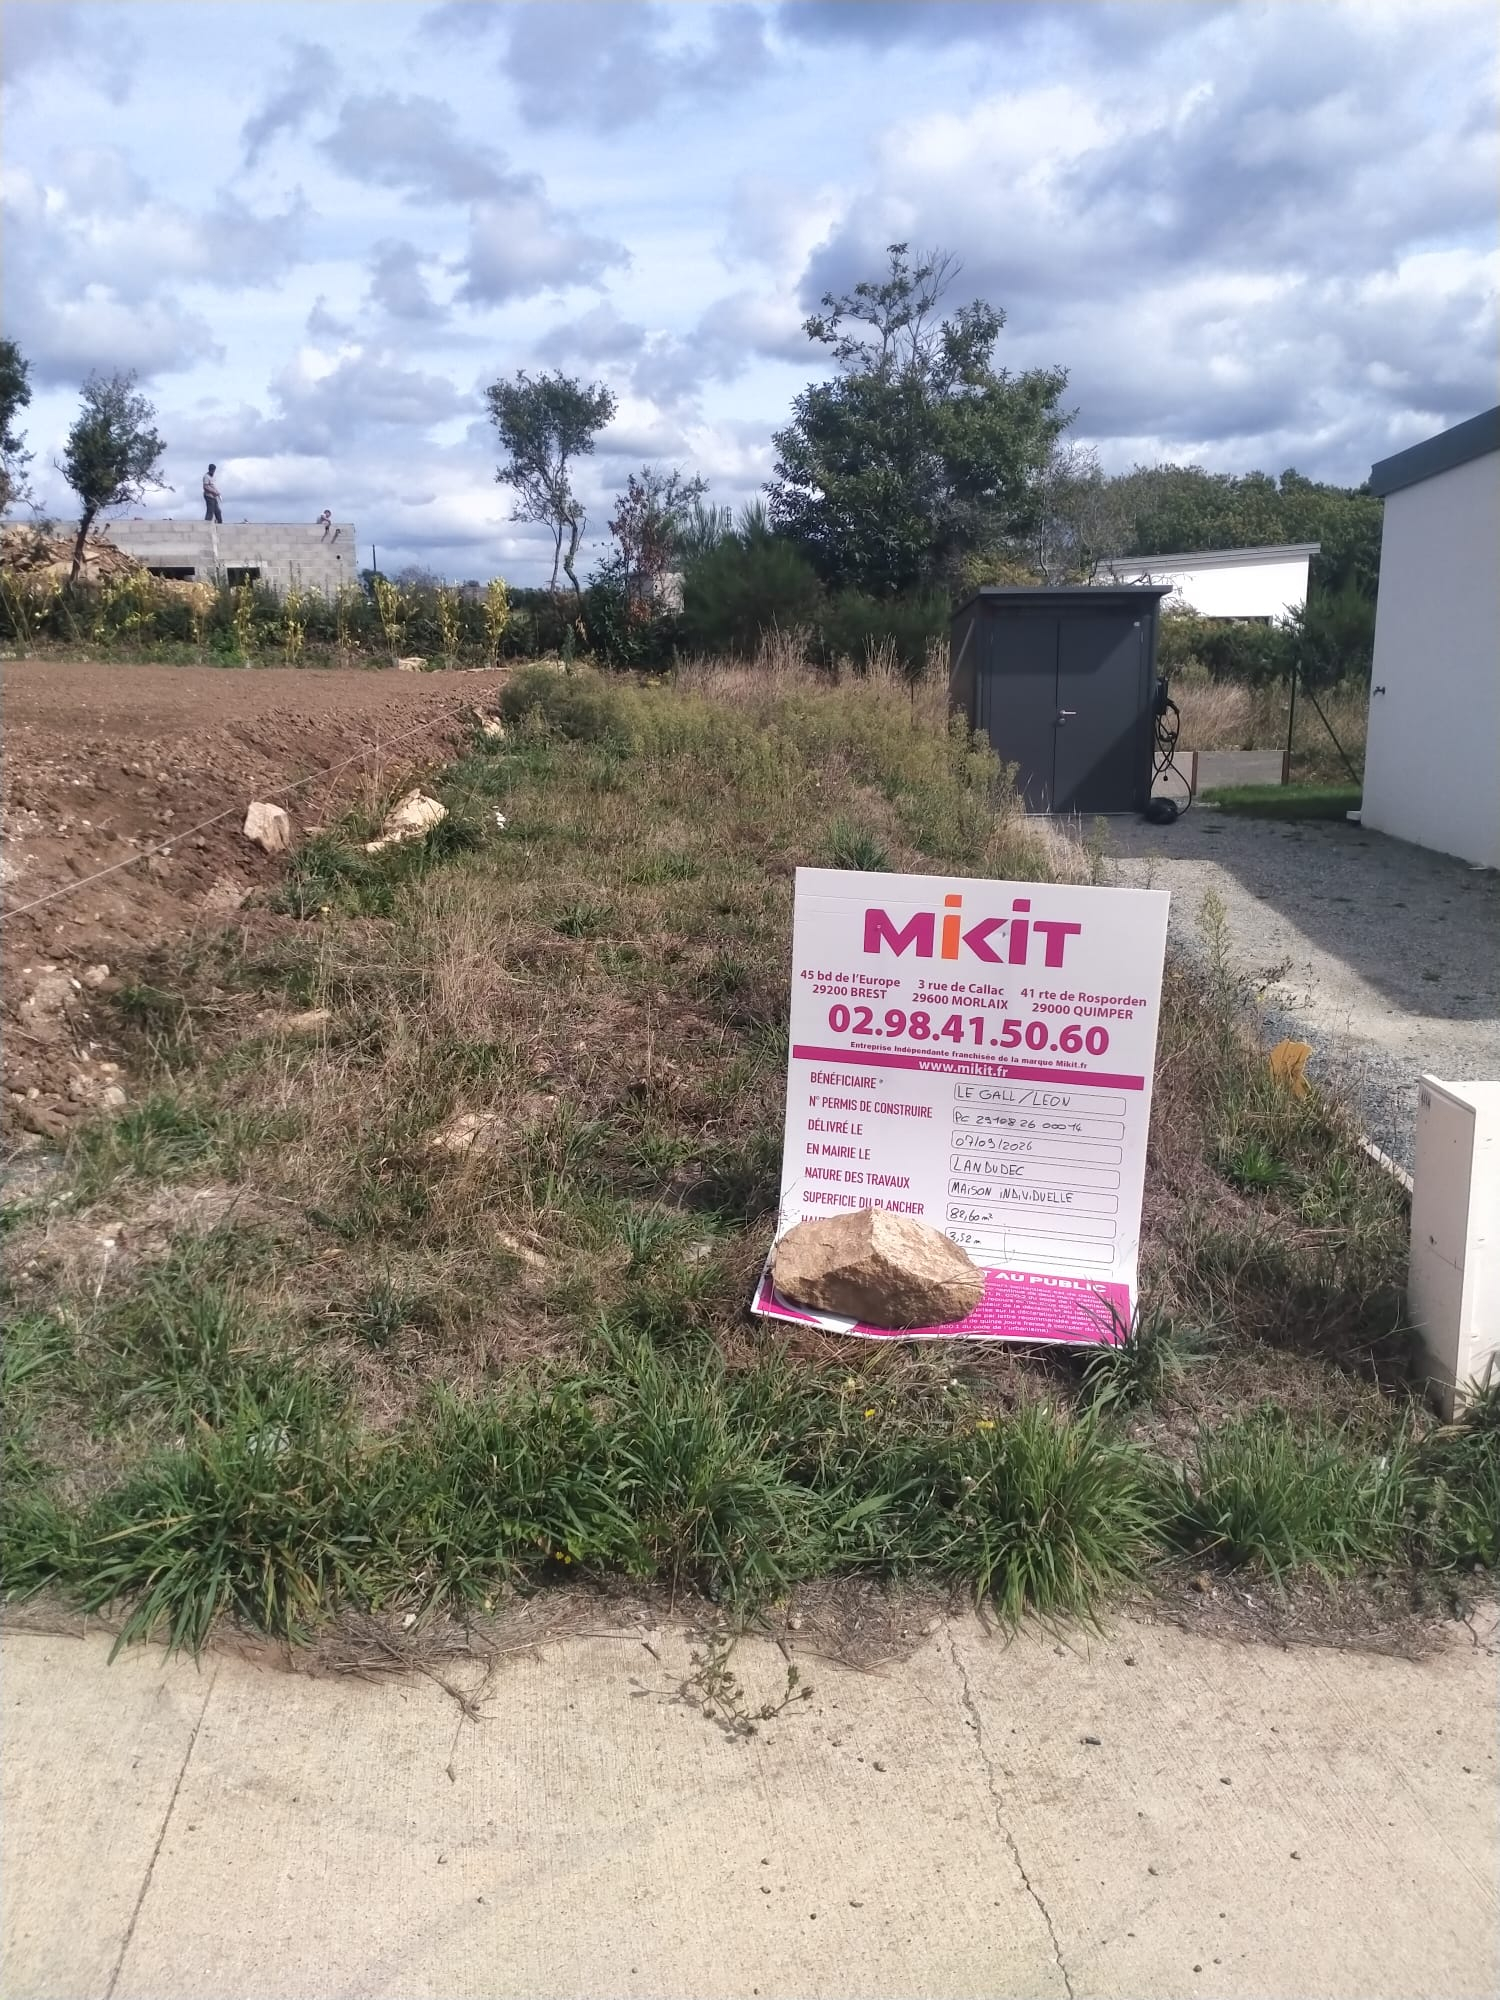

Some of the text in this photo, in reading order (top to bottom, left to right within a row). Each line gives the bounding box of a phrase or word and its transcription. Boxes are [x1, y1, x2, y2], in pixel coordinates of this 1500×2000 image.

[800, 970, 814, 980] 45
[818, 970, 832, 981] bd
[835, 972, 849, 982] de
[812, 984, 887, 999] 29200 BREST
[918, 980, 1004, 996] 3 rue de Callac
[1020, 988, 1147, 1006] 41 rte de Rosporden
[912, 993, 1008, 1010] 29600 MORLAIX
[1032, 1003, 1133, 1020] 29000 QUIMPER
[828, 1004, 1109, 1056] 02.98.41.50.60
[850, 1041, 892, 1052] Entreprise
[894, 1045, 949, 1056] Indépendante
[952, 1050, 996, 1060] franchisée
[1022, 1057, 1053, 1066] marque
[1056, 1060, 1087, 1069] Mikit.fr
[919, 1060, 1008, 1078] www.mikit.fr
[810, 1070, 877, 1089] BÉNÉFICIAIRE
[957, 1085, 974, 1098] LE
[809, 1095, 933, 1118] N° PERMIS DE CONSTRUIRE
[808, 1118, 863, 1135] DÉLIVRÉ LE
[1020, 1120, 1036, 1129] 26
[806, 1142, 871, 1160] EN MAIRIE LE
[804, 1166, 910, 1188] NATURE DES TRAVAUX
[802, 1190, 924, 1215] SUPERFICIE DU PLANCHER
[994, 1272, 1025, 1282] AU
[1029, 1276, 1107, 1292] PUBLIC
